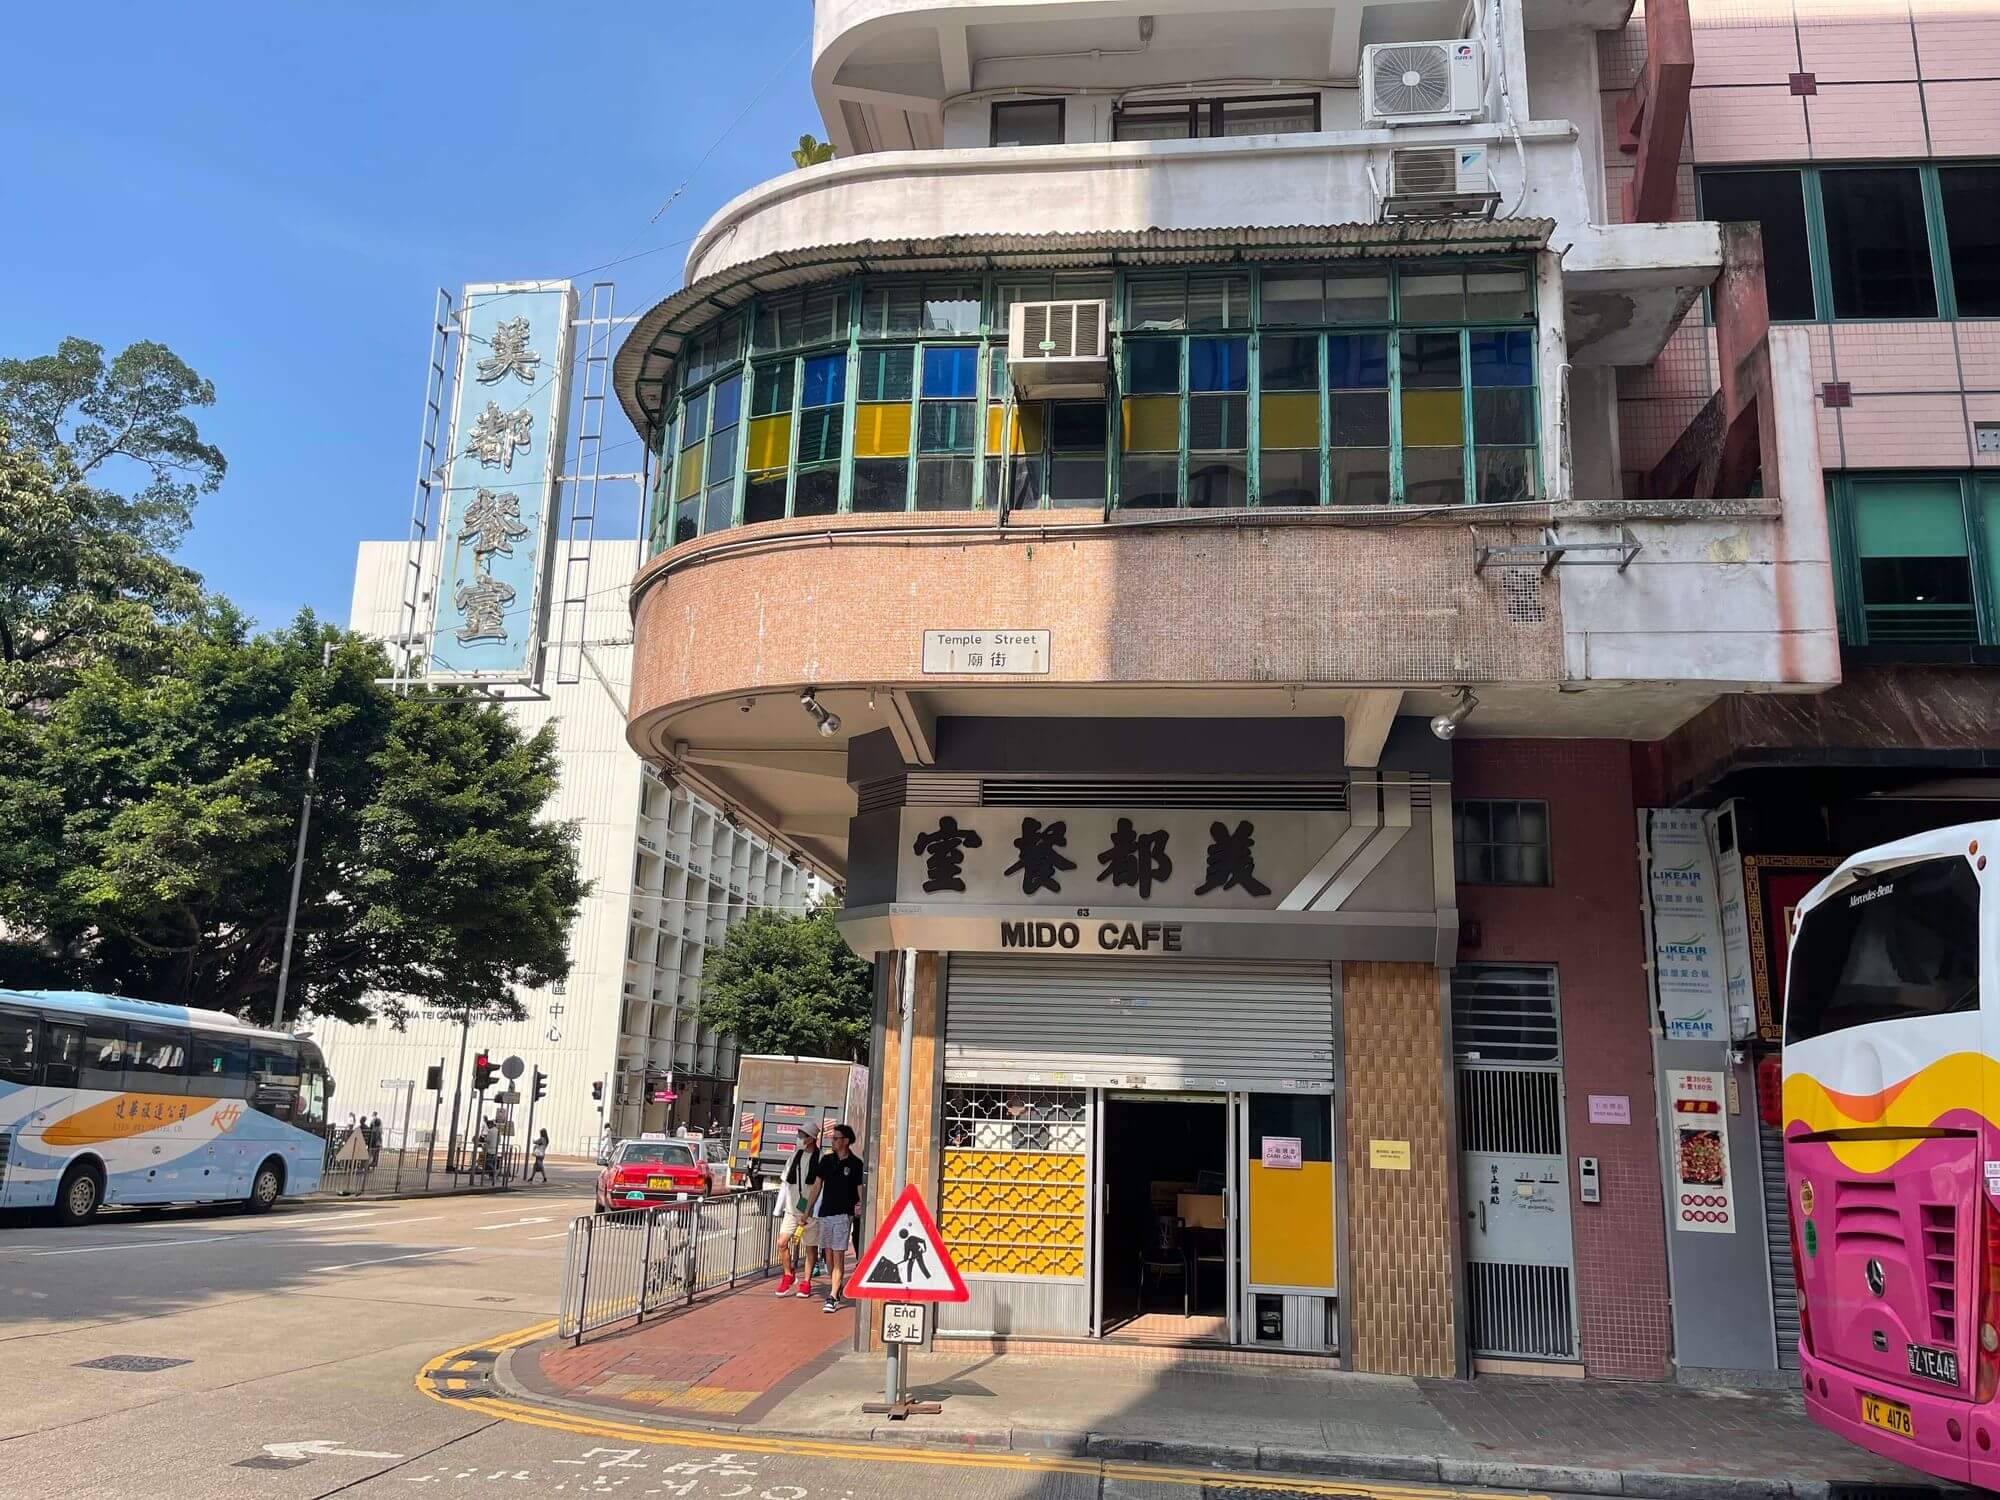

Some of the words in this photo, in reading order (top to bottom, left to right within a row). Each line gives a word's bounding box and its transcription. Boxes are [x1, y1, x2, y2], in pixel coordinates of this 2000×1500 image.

[455, 314, 541, 644] 美都餐室
[937, 634, 982, 647] Temple
[995, 634, 1037, 645] Street
[967, 652, 1007, 667] 廟街
[1653, 871, 1702, 880] LIKEAIR
[1849, 883, 1894, 908] Mercedes-Benz
[1076, 909, 1090, 917] 63
[1001, 922, 1080, 949] MIDO
[1098, 922, 1183, 951] CAFE
[1658, 945, 1707, 954] LIKEAIR
[894, 1307, 916, 1319] End
[887, 1323, 920, 1339] 終止
[1865, 1401, 1881, 1423] VC
[1887, 1404, 1911, 1434] 4178
